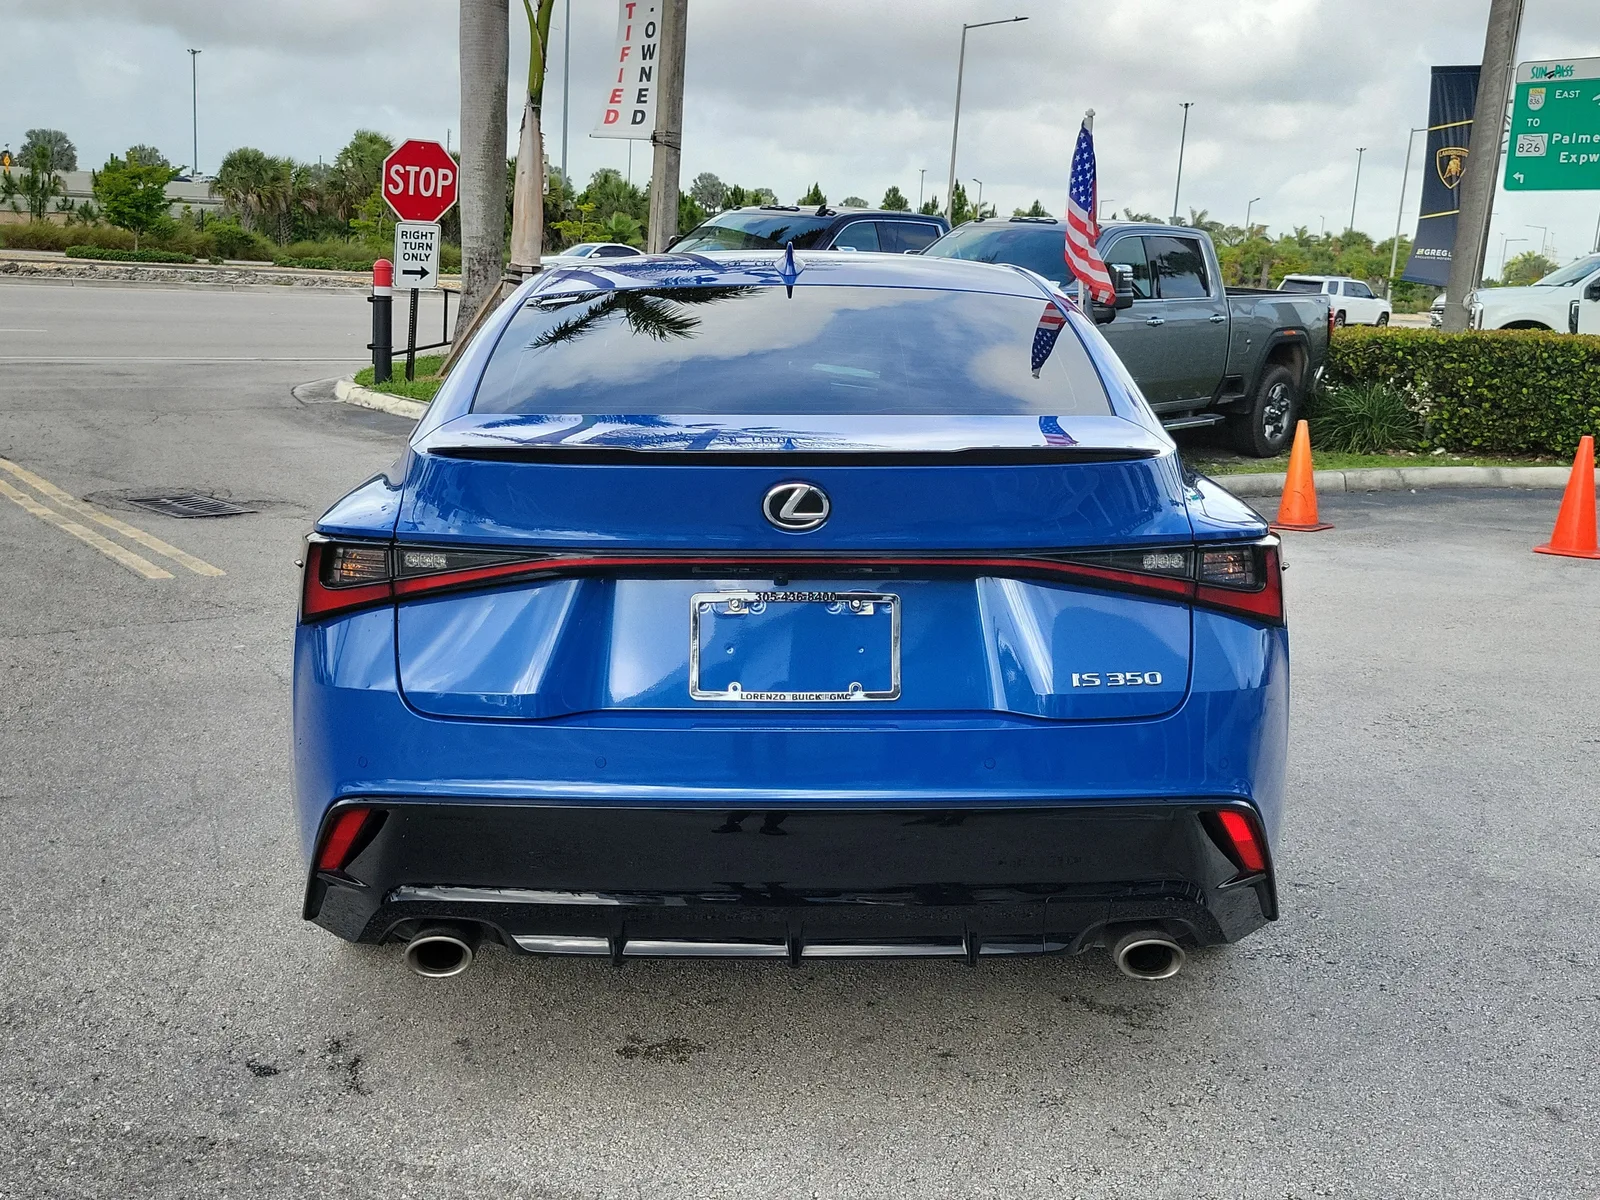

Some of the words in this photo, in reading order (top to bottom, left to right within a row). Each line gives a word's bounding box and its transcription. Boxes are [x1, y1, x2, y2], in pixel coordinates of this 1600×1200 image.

[1555, 89, 1581, 99] EAST
[1526, 117, 1541, 127] TO
[1517, 142, 1541, 153] 826
[387, 164, 454, 198] STOP
[400, 230, 436, 241] RIGHT
[402, 241, 433, 251] TURN
[402, 252, 431, 262] ONLY
[755, 591, 837, 602] 305-436-8400
[1071, 671, 1101, 688] IS
[1105, 671, 1163, 687] 350
[740, 692, 786, 701] LORENZO
[791, 692, 821, 701] BUICK
[829, 692, 852, 701] GMC
